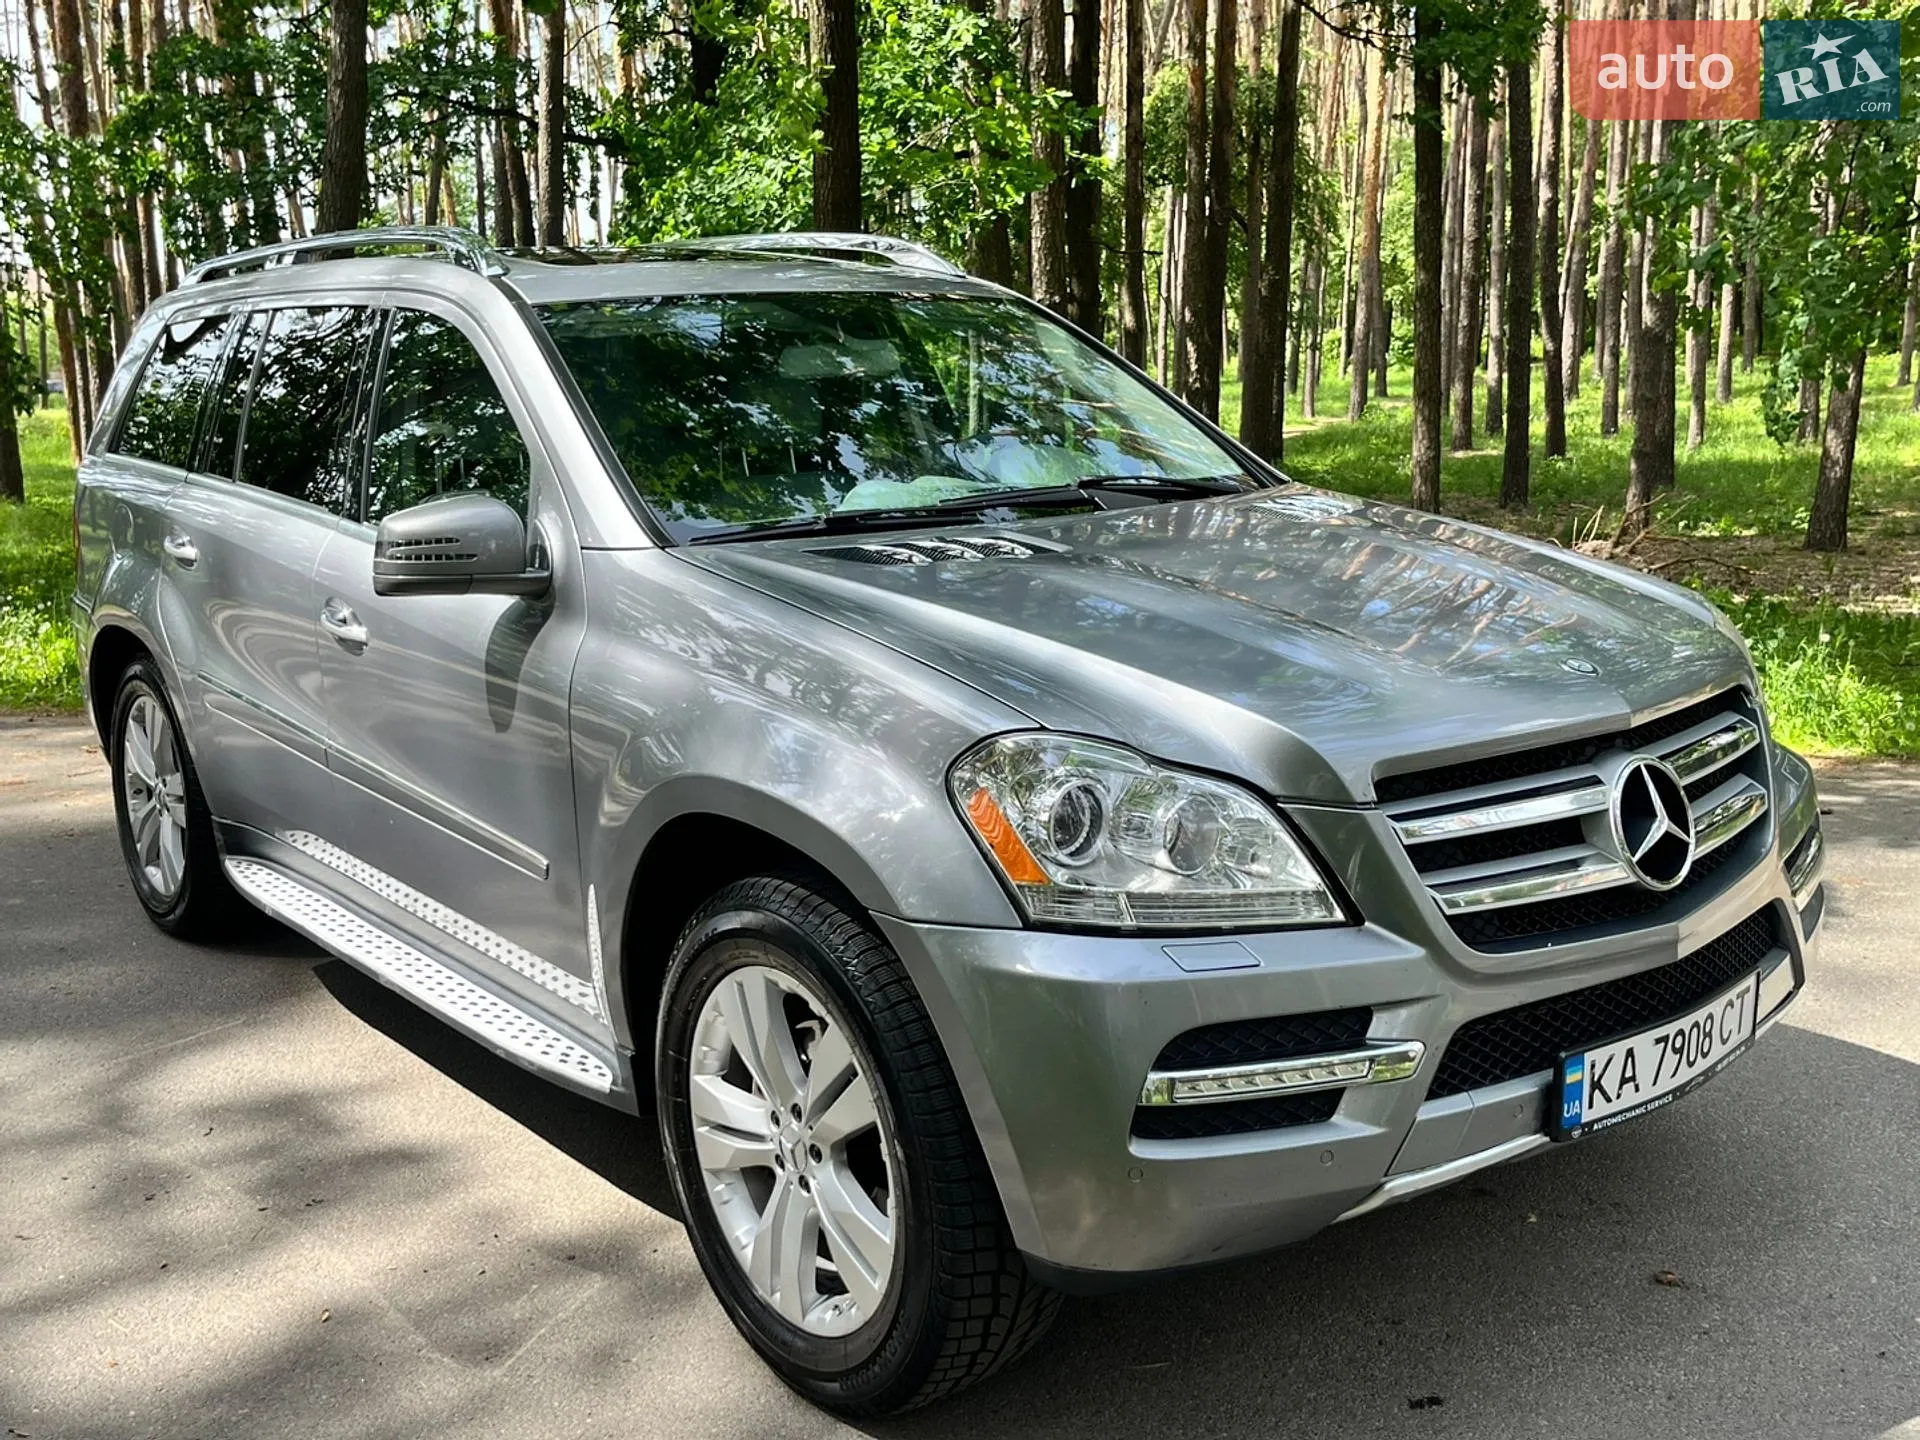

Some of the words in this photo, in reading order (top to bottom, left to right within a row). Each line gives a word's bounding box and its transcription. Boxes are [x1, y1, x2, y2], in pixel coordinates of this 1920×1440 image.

[1587, 1046, 1640, 1109] KA
[1652, 1011, 1714, 1087] 7908
[1719, 987, 1751, 1046] CT
[1563, 1101, 1581, 1118] UA
[1592, 1110, 1647, 1131] AUTOMECHANIC
[1646, 1093, 1674, 1113] SERVICE
